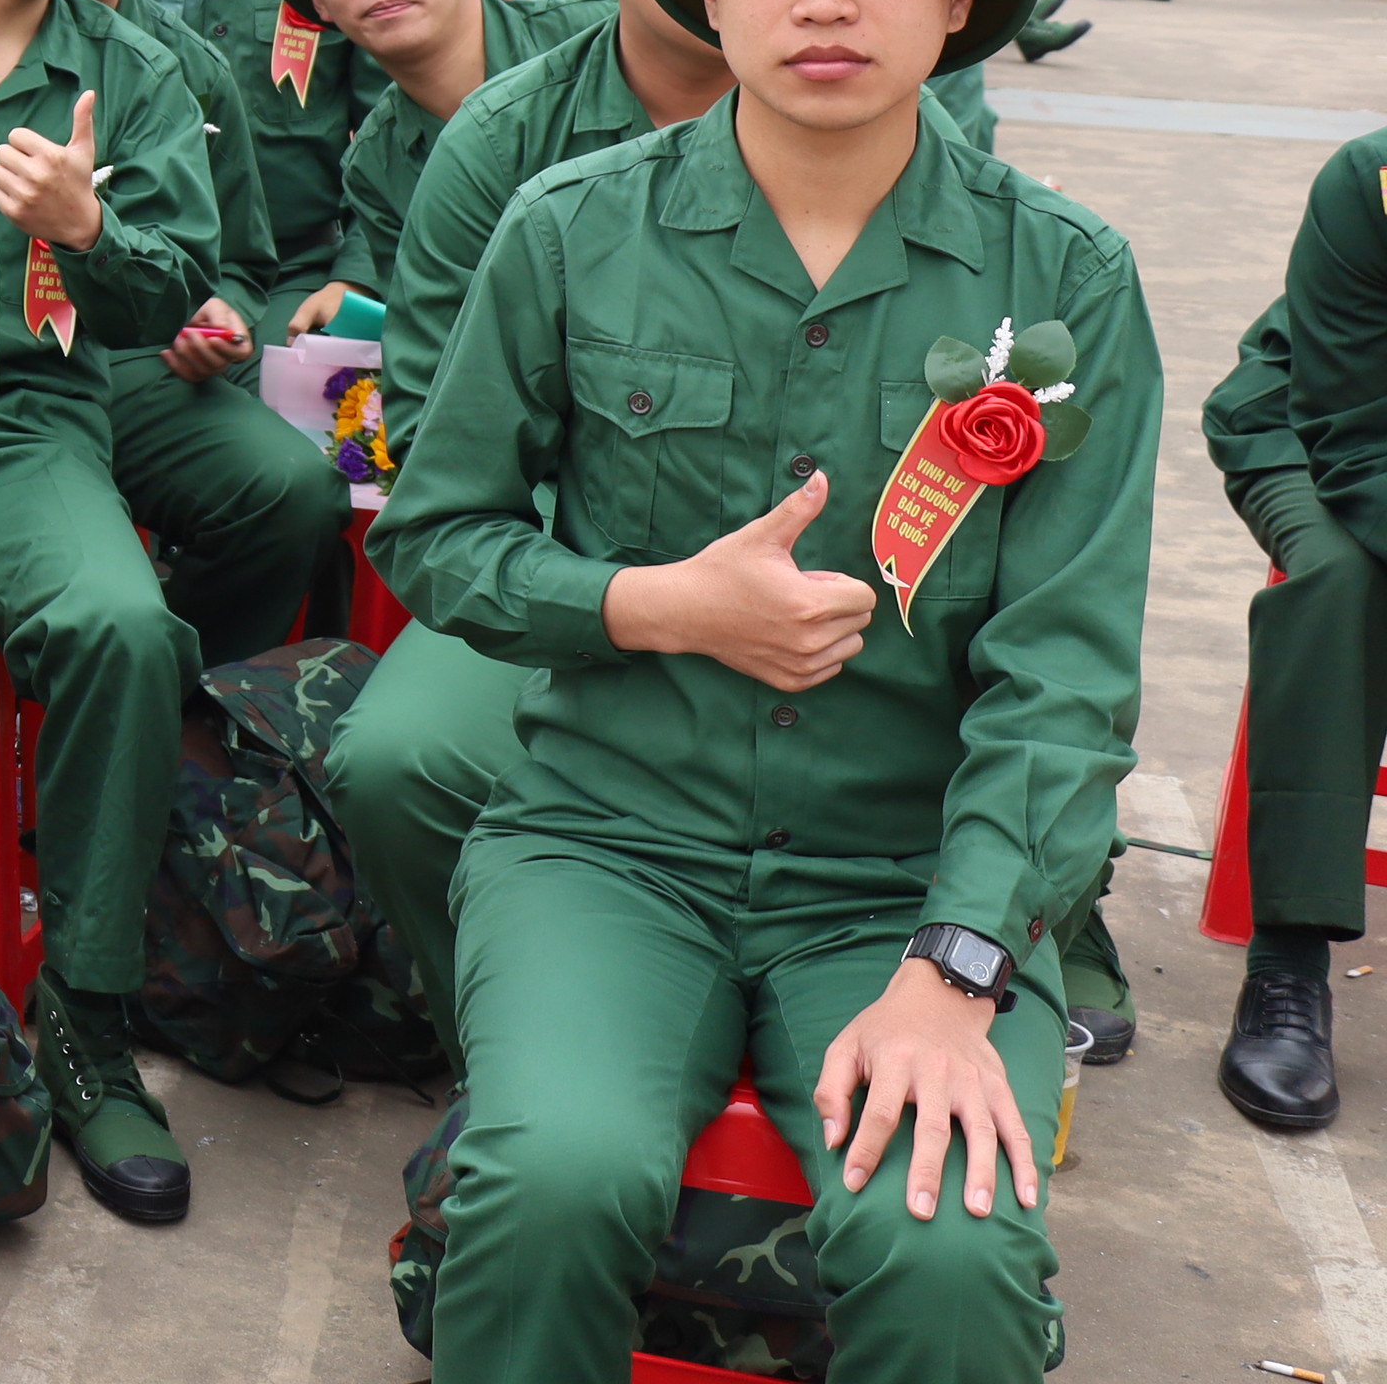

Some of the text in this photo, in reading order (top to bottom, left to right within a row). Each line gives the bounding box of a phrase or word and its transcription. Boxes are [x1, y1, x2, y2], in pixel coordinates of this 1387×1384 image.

[897, 470, 921, 493] LÊN
[916, 457, 967, 496] VINH DỰ
[897, 495, 921, 518] BẢO
[887, 511, 929, 548] TỔ QUỐC
